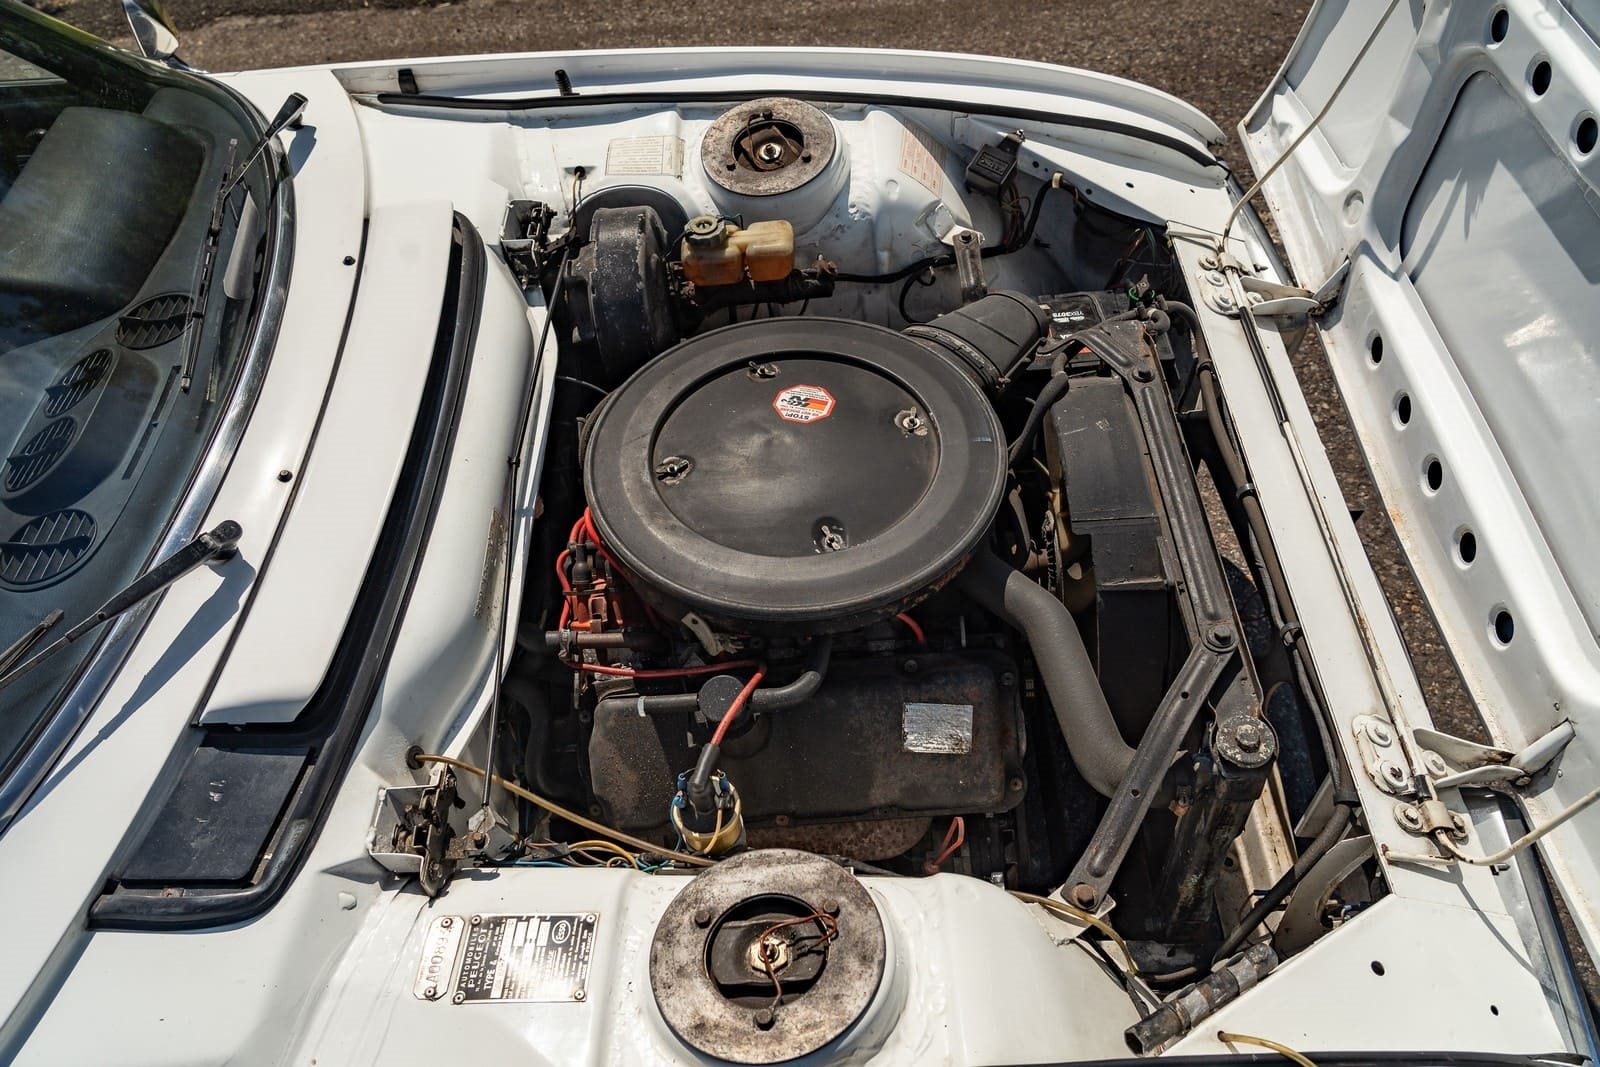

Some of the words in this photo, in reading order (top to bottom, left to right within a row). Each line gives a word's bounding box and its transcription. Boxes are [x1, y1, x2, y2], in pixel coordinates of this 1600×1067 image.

[785, 412, 810, 420] STOP!
[555, 923, 566, 940] Esso
[460, 927, 480, 988] AUTOMOBILES
[467, 928, 488, 988] PEUGEOT
[483, 968, 495, 990] TYPE
